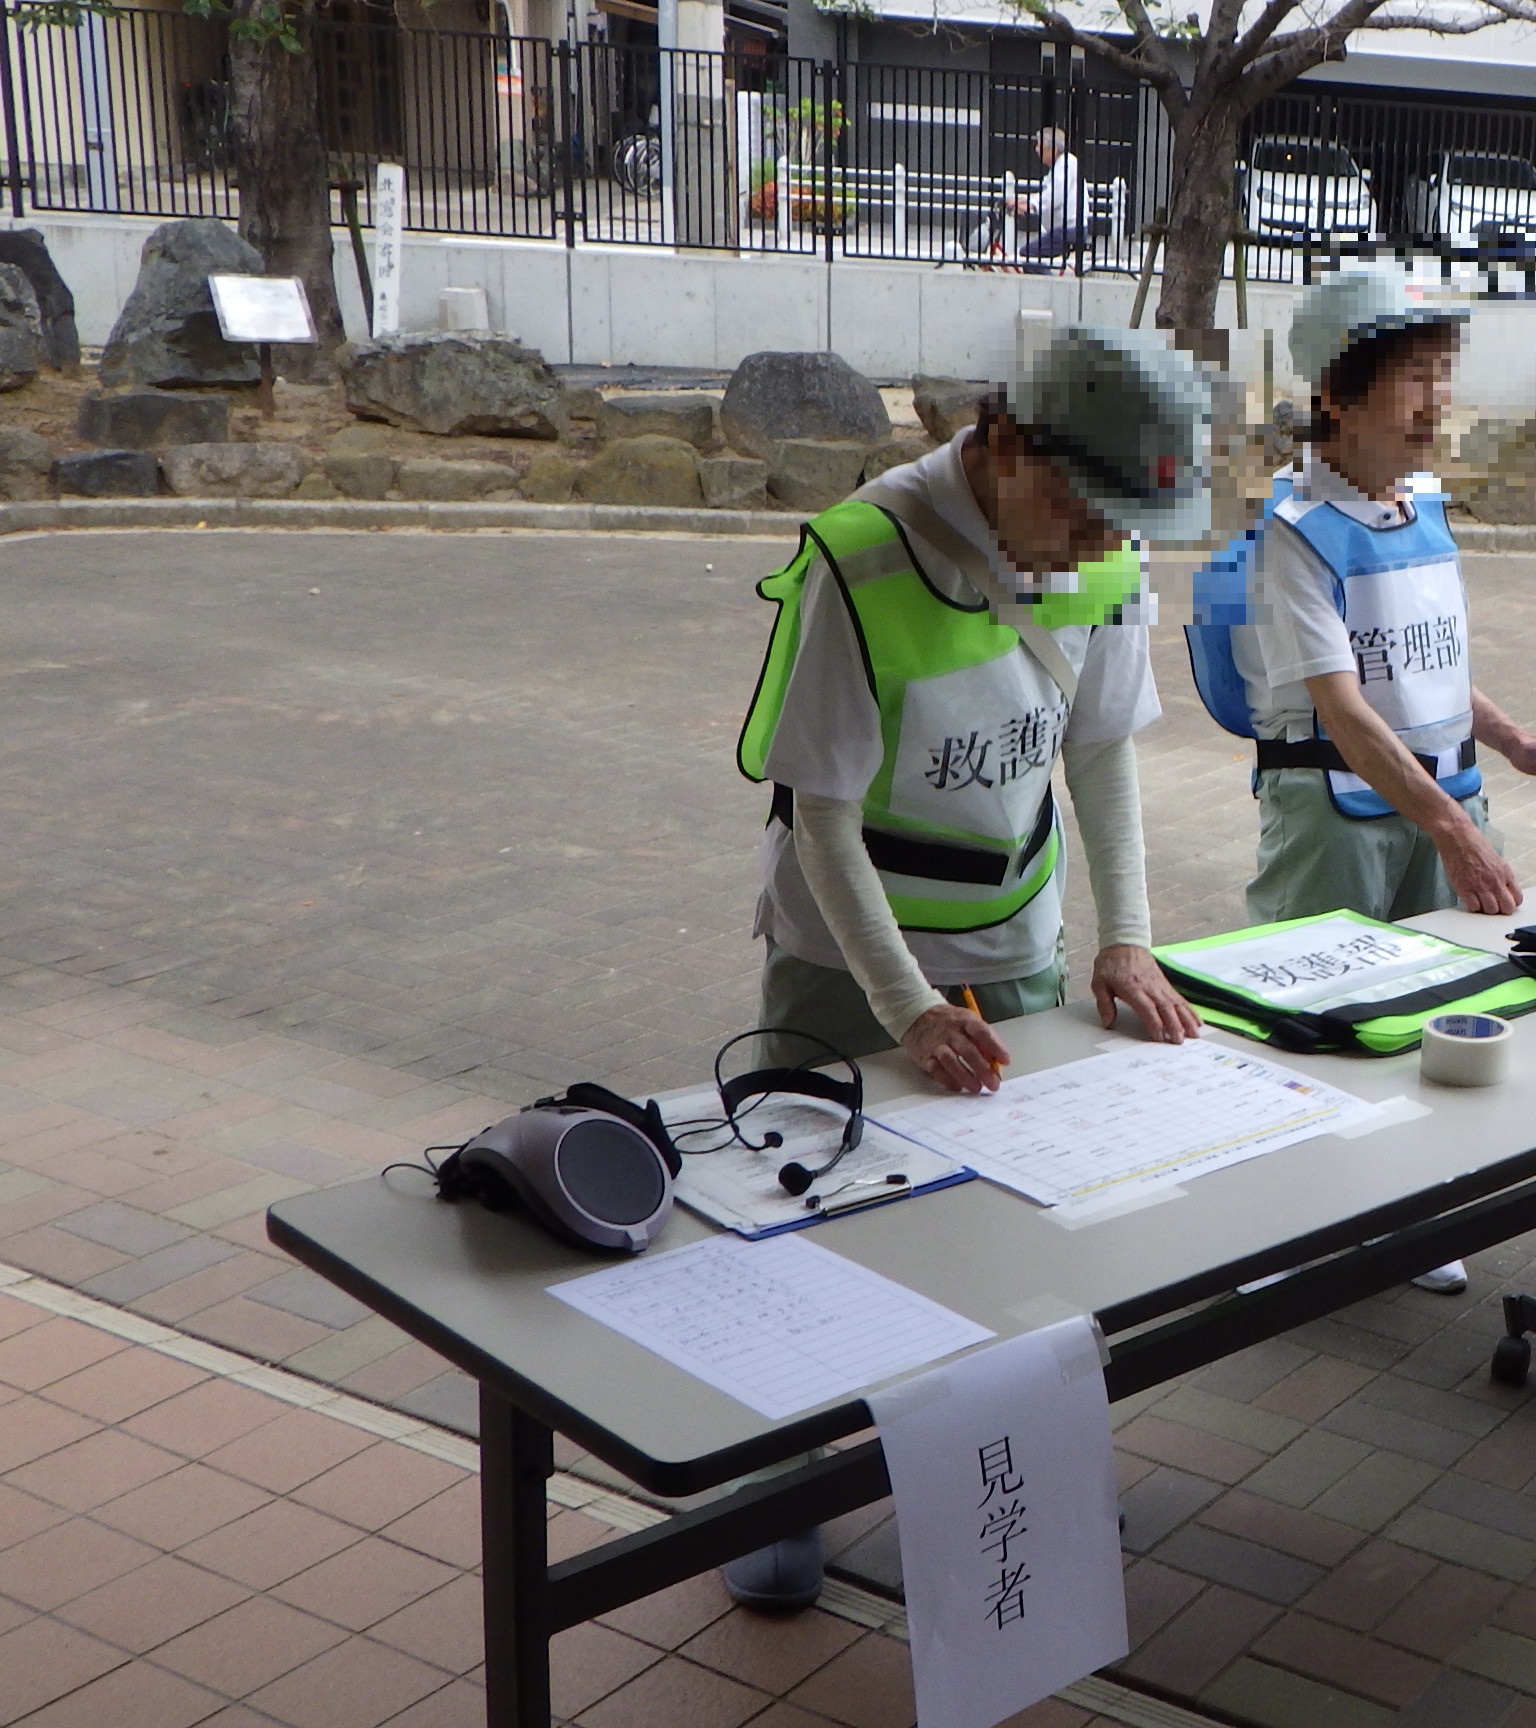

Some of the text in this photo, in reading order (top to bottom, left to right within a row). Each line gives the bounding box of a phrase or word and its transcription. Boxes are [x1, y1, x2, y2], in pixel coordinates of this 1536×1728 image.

[1348, 614, 1462, 686] 管理部
[1241, 934, 1402, 988] 救護部
[976, 1435, 1032, 1631] 見学者
